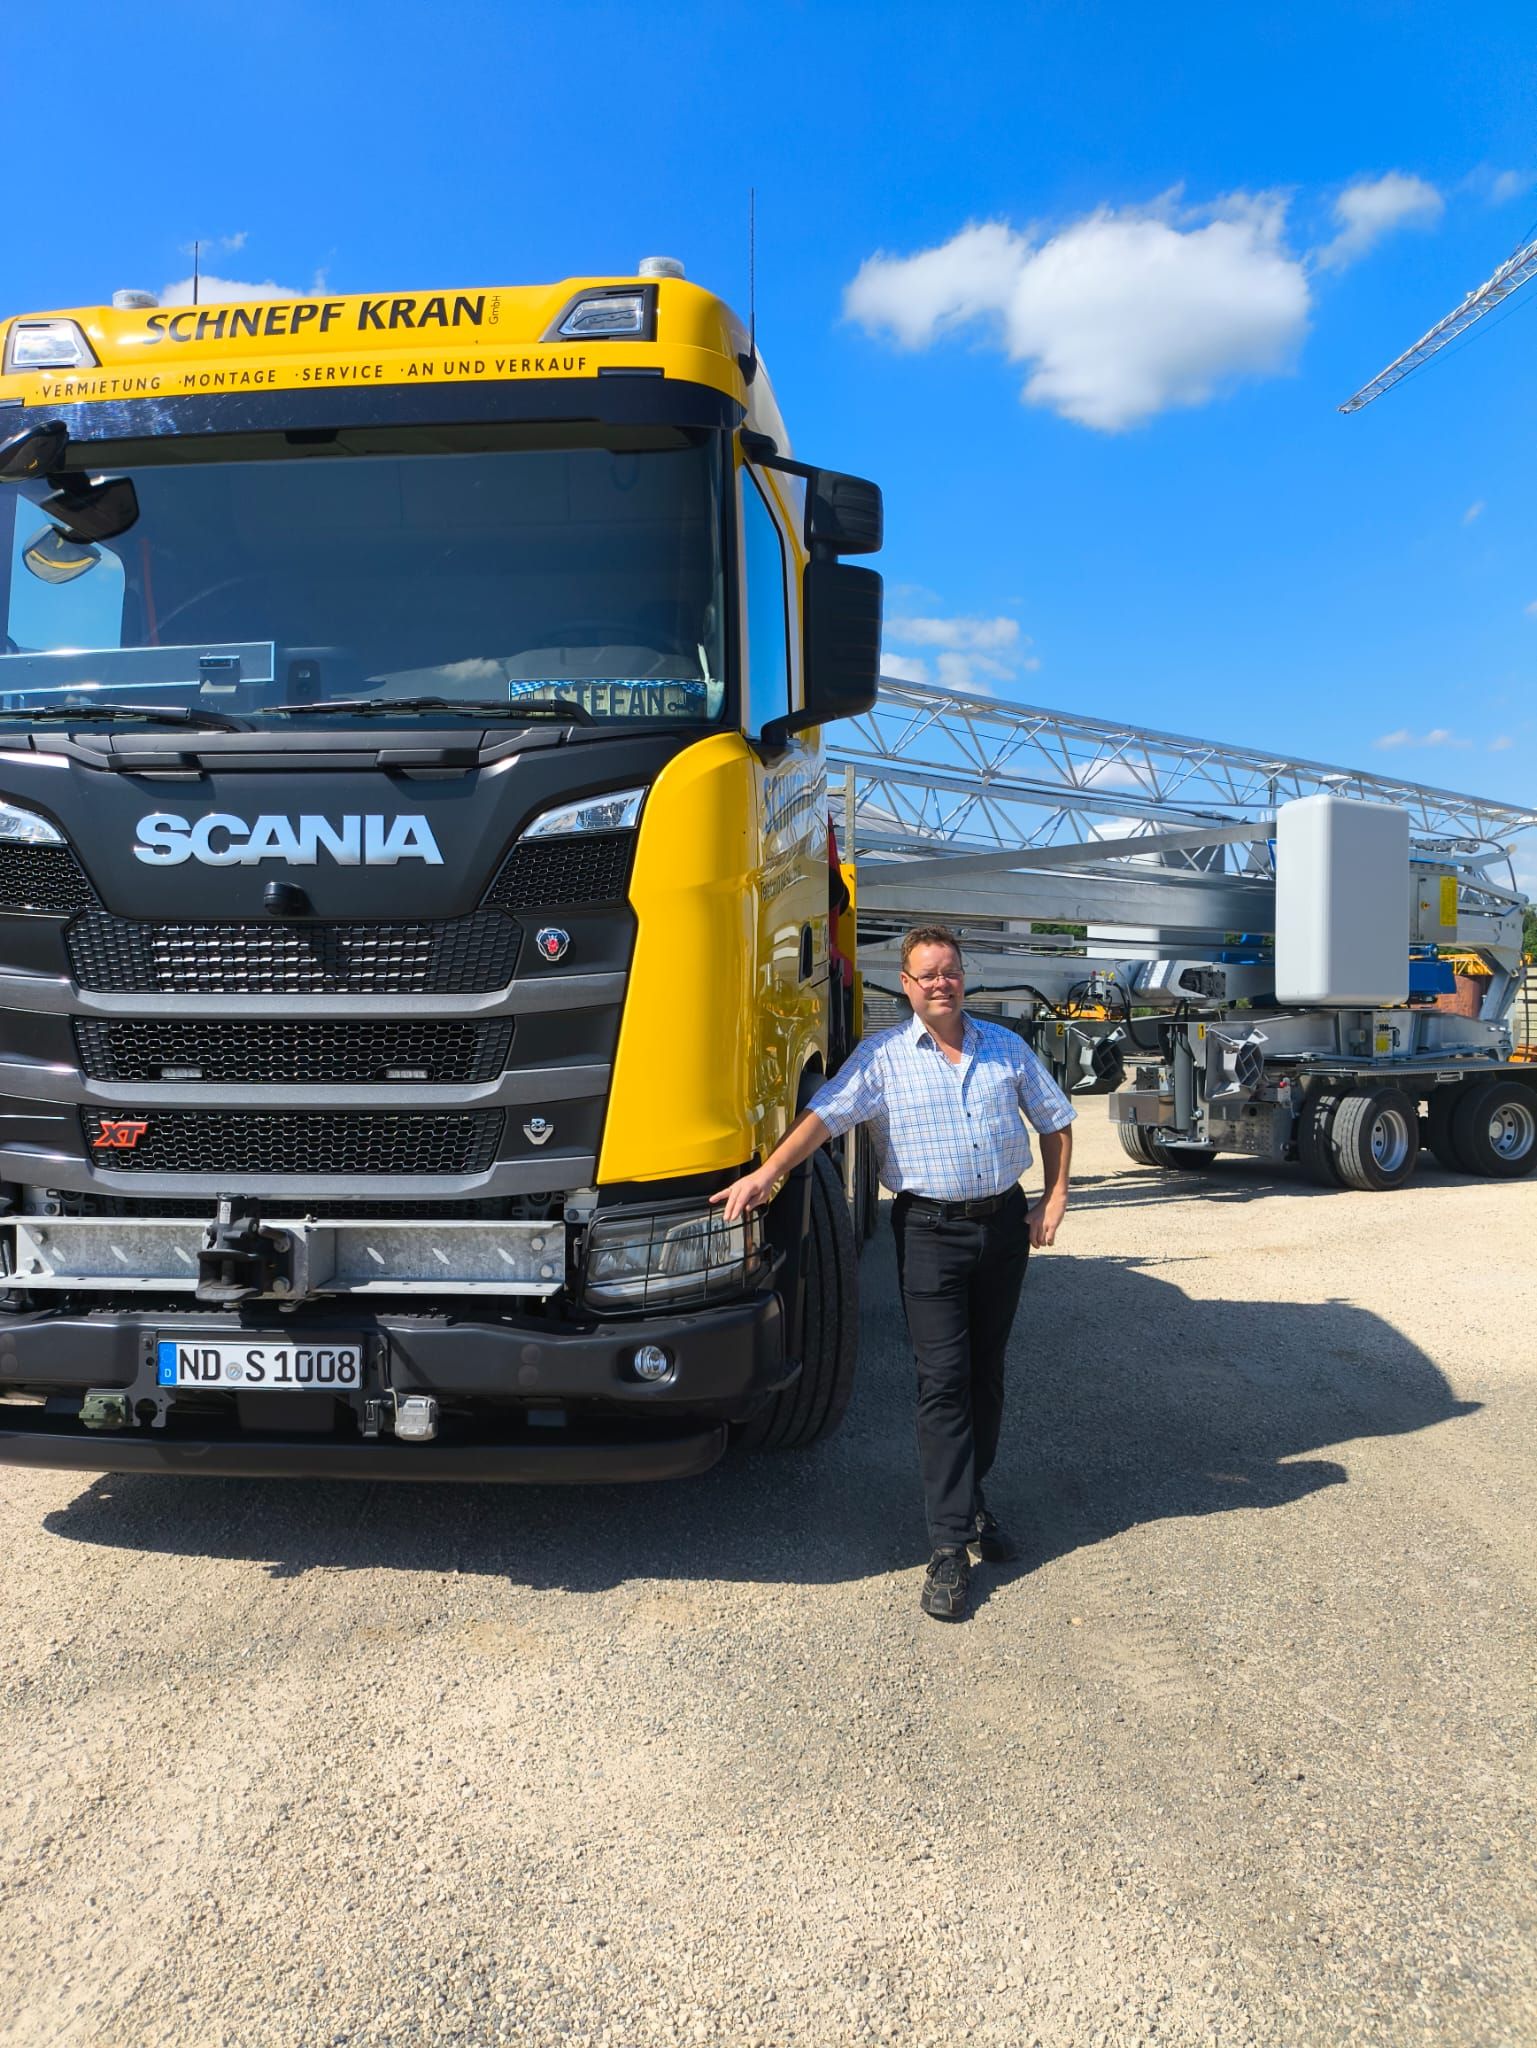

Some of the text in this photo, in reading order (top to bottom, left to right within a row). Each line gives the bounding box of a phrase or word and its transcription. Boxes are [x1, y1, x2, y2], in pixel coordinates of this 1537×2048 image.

[143, 296, 486, 345] SCHNEPF KRAN
[489, 296, 501, 325] GmbH
[444, 360, 485, 375] UND
[495, 357, 587, 373] VERKAUF
[133, 813, 445, 866] SCANIA
[93, 1120, 149, 1147] XT
[164, 1368, 172, 1378] D
